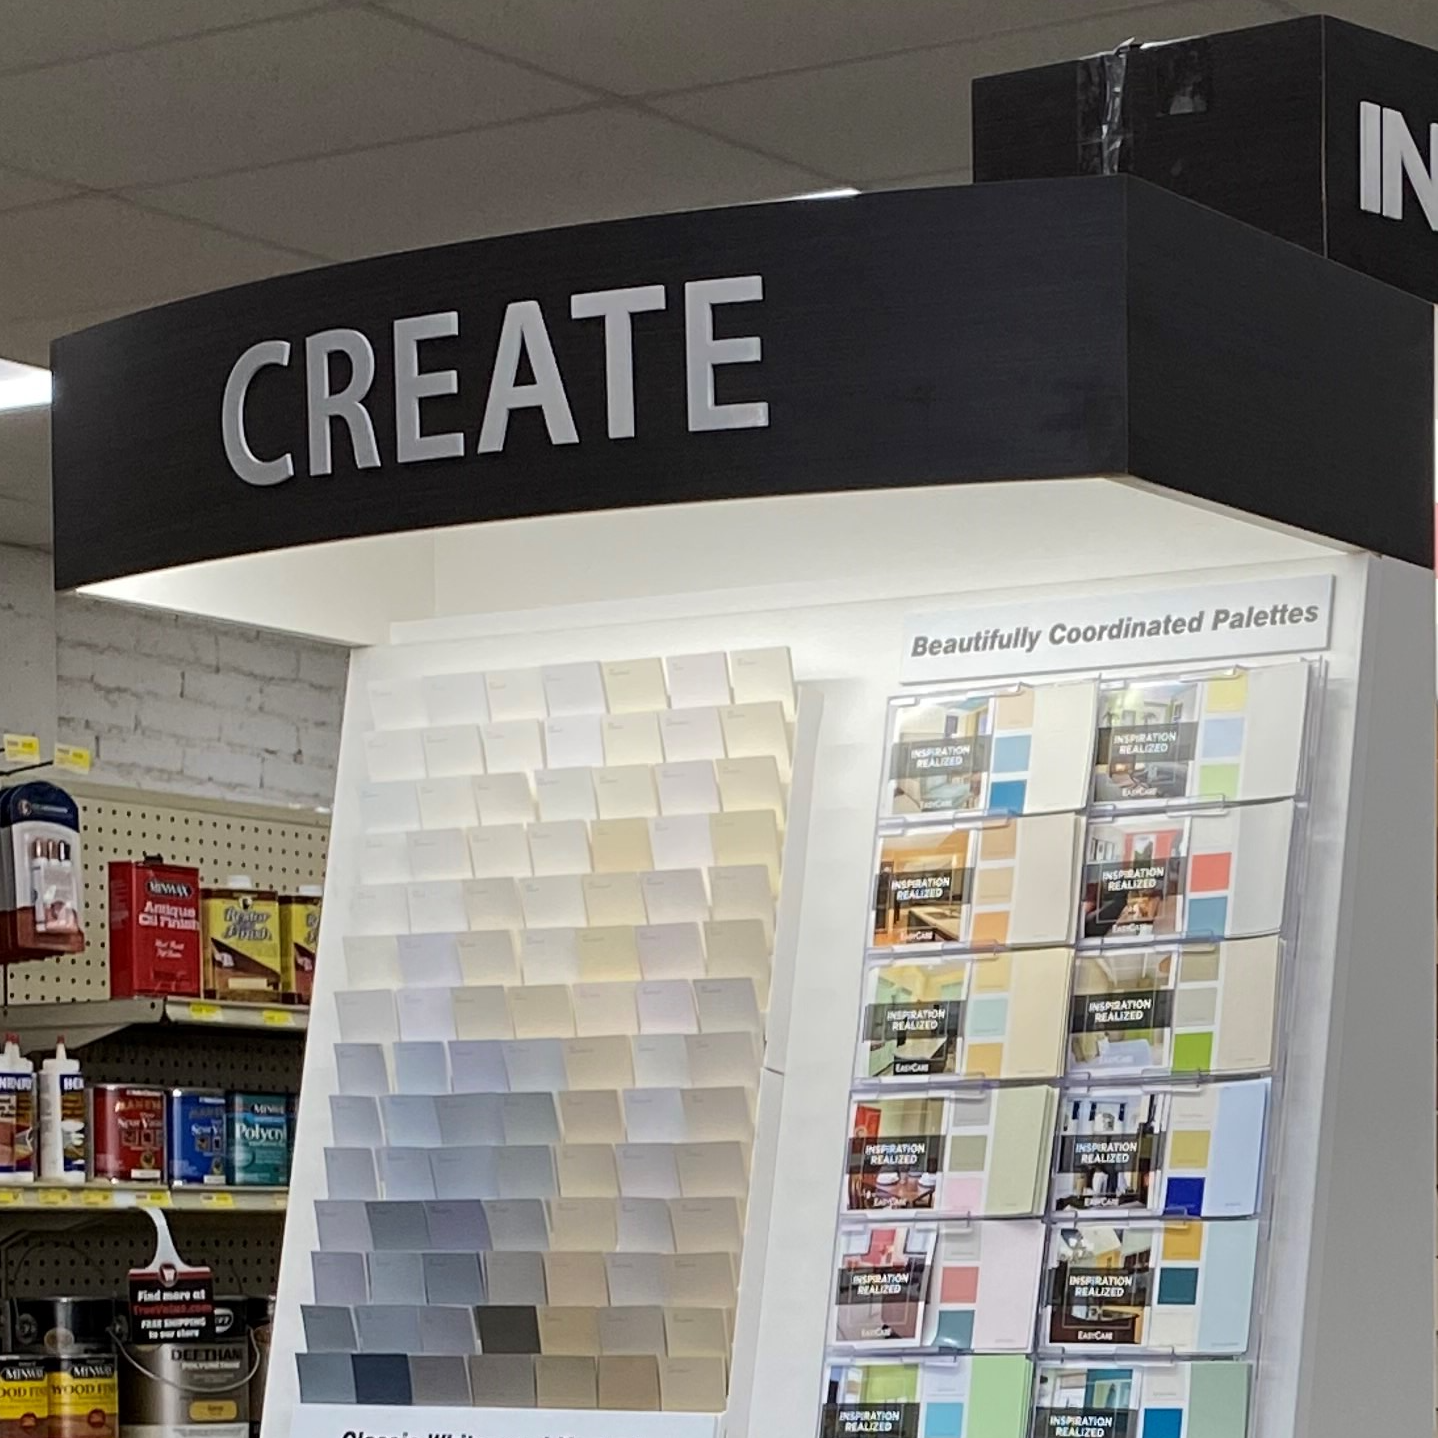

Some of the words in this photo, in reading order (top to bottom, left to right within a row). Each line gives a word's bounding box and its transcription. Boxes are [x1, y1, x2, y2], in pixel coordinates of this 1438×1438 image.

[221, 274, 770, 487] CREATE
[911, 626, 1040, 658] Beautifully
[1048, 610, 1204, 645] Coordinated
[1211, 601, 1319, 632] Palettes
[1114, 732, 1176, 746] INSPIRATION
[911, 744, 970, 758] INSPIRATION
[1119, 742, 1169, 754] REALIZED
[917, 755, 962, 768] REALIZED
[1103, 867, 1164, 881] INSPIRATION
[891, 876, 950, 890] INSPIRATION
[1108, 878, 1156, 890] REALIZED
[897, 887, 943, 900] REALIZED
[144, 901, 196, 917] Antique
[1089, 998, 1151, 1013] INSPIRATION
[887, 1009, 945, 1020] INSPIRATION
[1095, 1009, 1143, 1022] REALIZED
[892, 1020, 938, 1031] REALIZED
[866, 1143, 924, 1155] INSPIRATION
[1076, 1142, 1137, 1153] INSPIRATION
[871, 1153, 917, 1165] REALIZED
[1081, 1152, 1129, 1164] REALIZED
[853, 1273, 908, 1285] INSPIRATION
[1069, 1275, 1132, 1287] INSPIRATION
[858, 1283, 901, 1294] REALIZED
[1075, 1285, 1124, 1297] REALIZED
[137, 1289, 161, 1302] Find
[163, 1290, 190, 1300] more
[193, 1289, 205, 1299] at
[141, 1318, 162, 1329] FREE
[164, 1317, 206, 1328] SHIPPING
[149, 1330, 158, 1339] to
[177, 1328, 200, 1338] store
[839, 1411, 900, 1422] INSPIRATION
[1050, 1415, 1112, 1427] INSPIRATION
[845, 1421, 893, 1433] REALIZED
[1055, 1426, 1105, 1438] REALIZED
